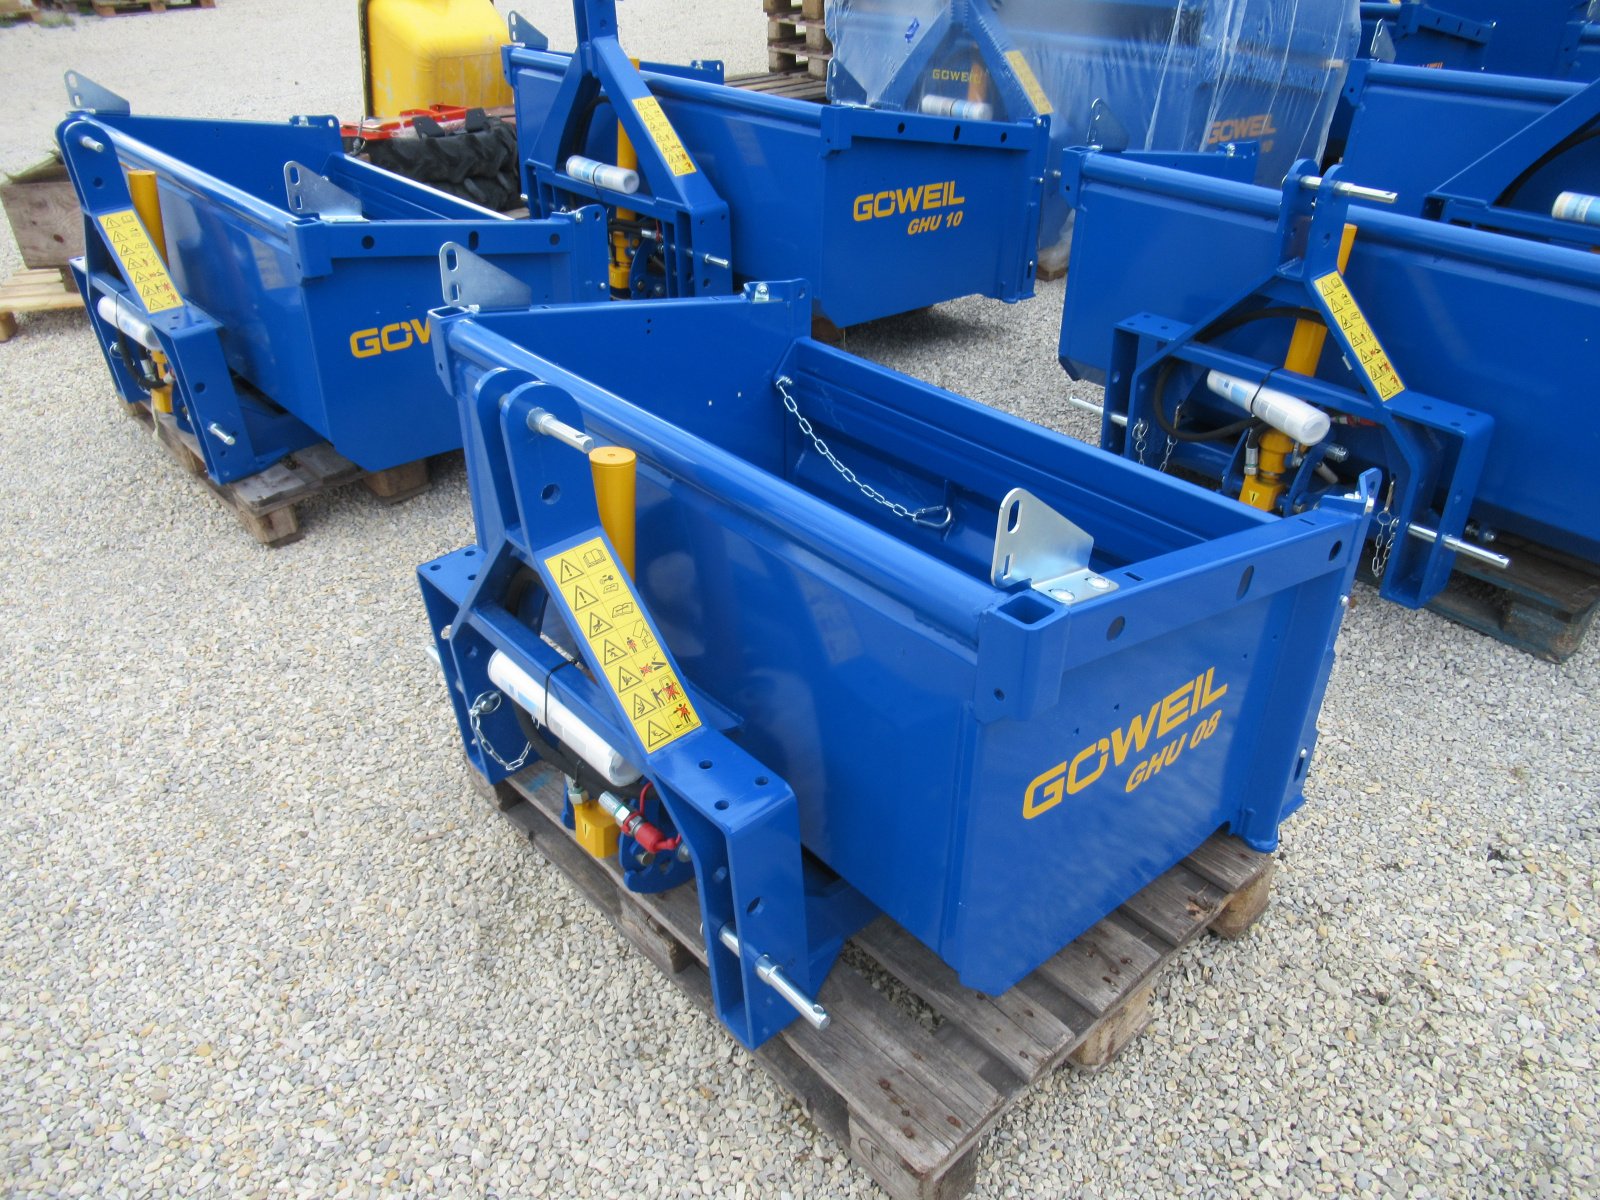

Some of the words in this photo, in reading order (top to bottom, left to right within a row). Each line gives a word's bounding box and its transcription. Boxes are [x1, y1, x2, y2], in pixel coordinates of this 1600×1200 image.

[907, 214, 942, 236] GHU
[946, 210, 964, 228] 10
[1125, 733, 1188, 793] GHU
[1189, 709, 1222, 750] 08
